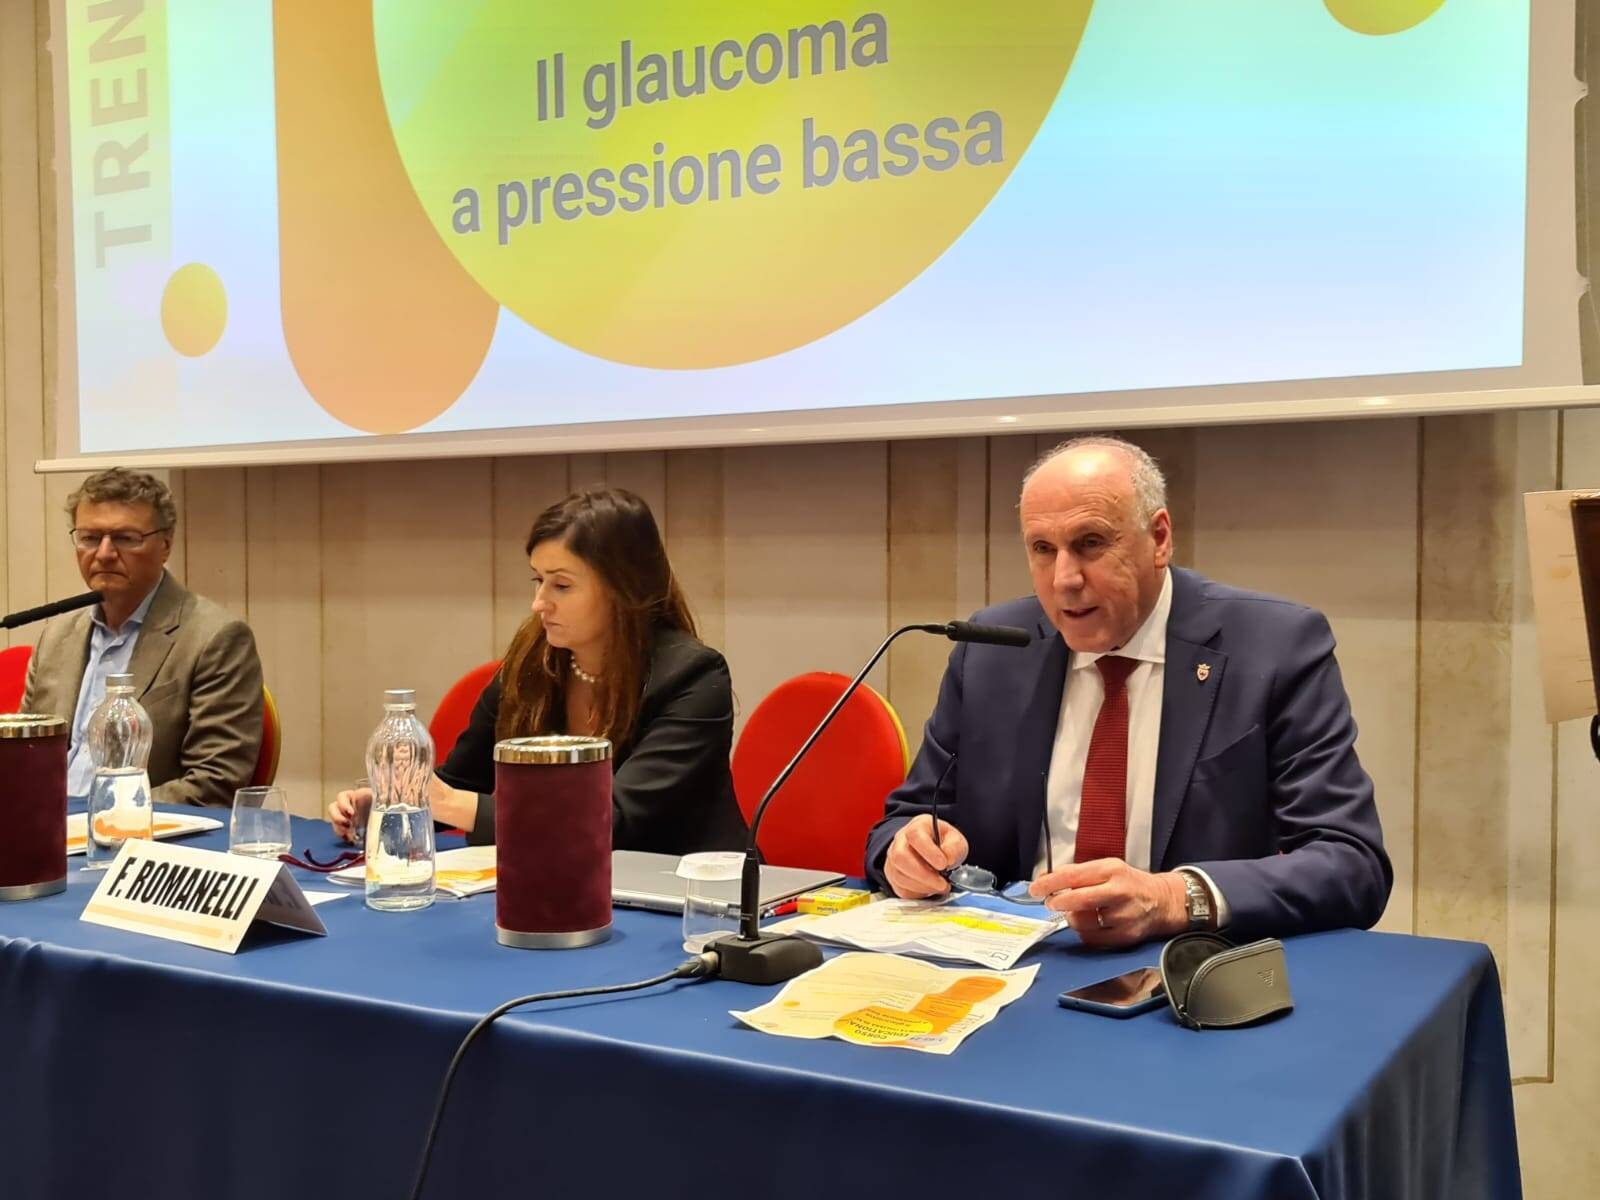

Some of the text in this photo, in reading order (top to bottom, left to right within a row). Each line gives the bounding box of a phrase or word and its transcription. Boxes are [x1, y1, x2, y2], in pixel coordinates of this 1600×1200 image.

[536, 11, 888, 129] Il glaucoma
[452, 110, 1004, 245] a pressione bassa
[107, 856, 138, 897] F.
[125, 861, 260, 920] ROMANELLI
